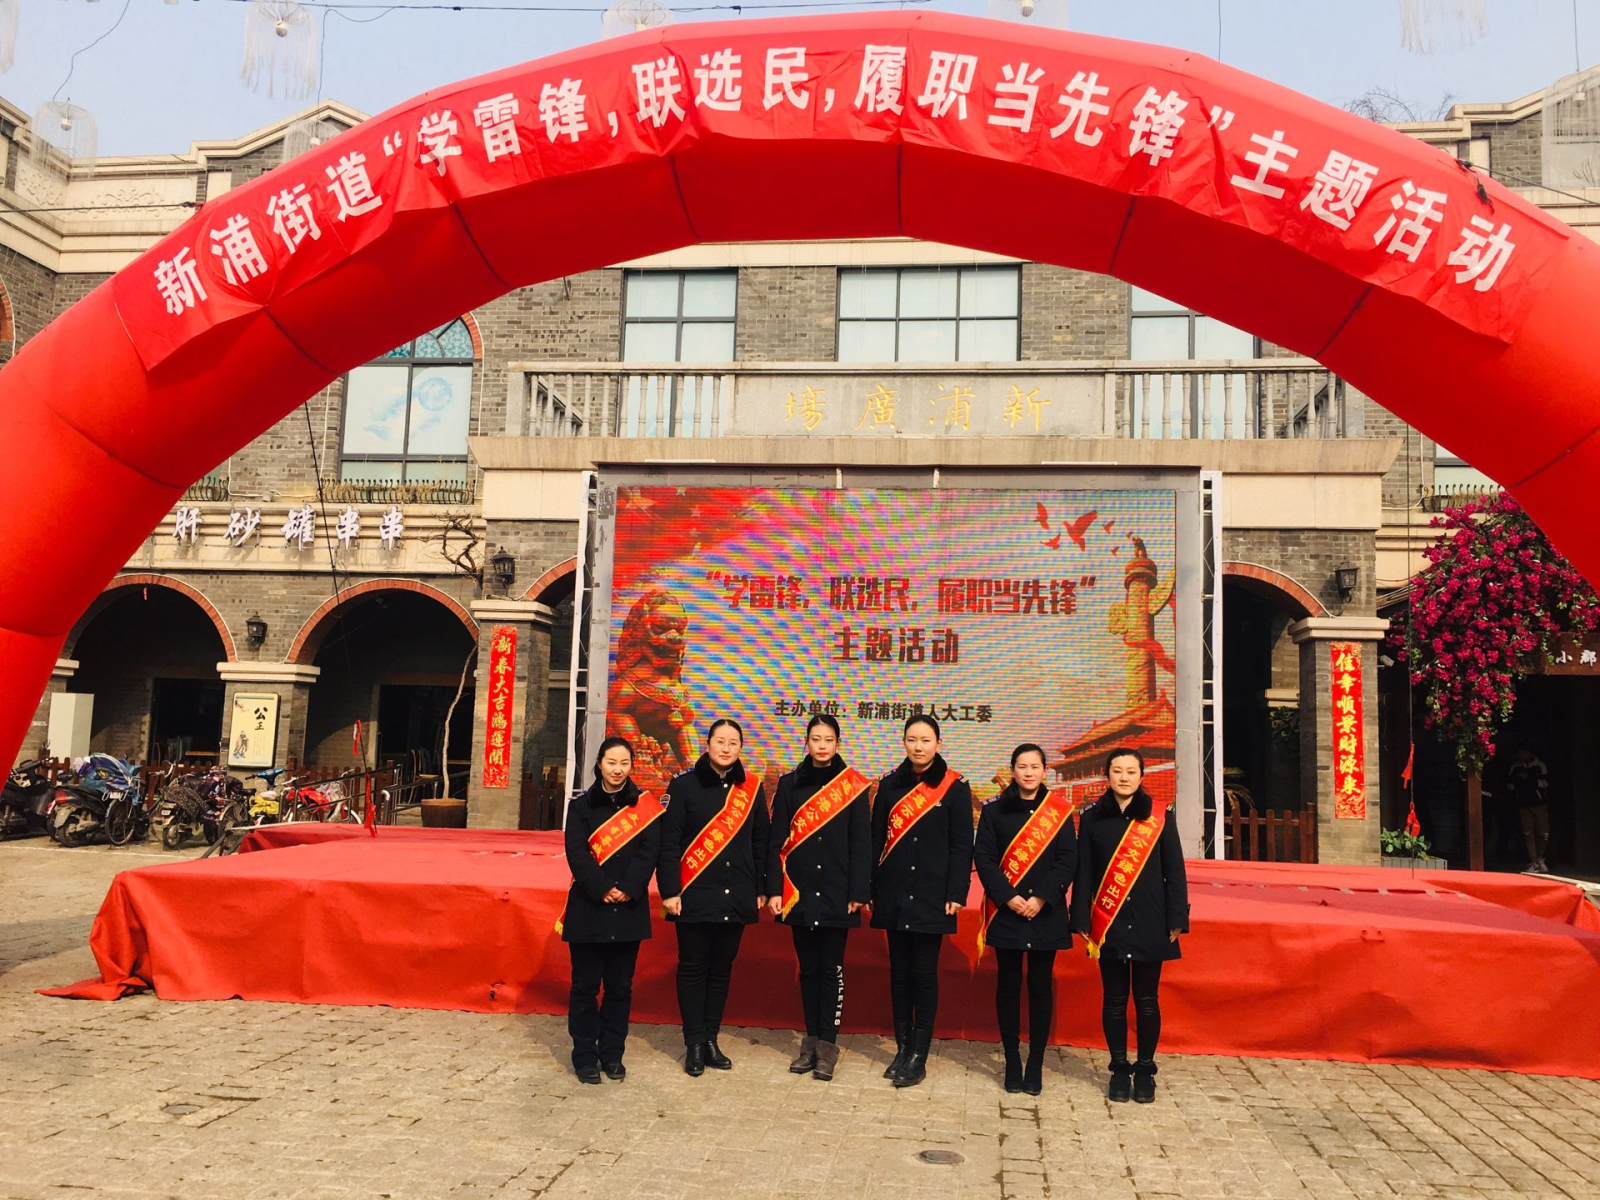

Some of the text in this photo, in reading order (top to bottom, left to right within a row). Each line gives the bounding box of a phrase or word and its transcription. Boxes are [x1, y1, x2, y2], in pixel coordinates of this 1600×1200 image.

[832, 626, 960, 664] 主题活动
[1100, 815, 1159, 910] 文明公交绿色出行
